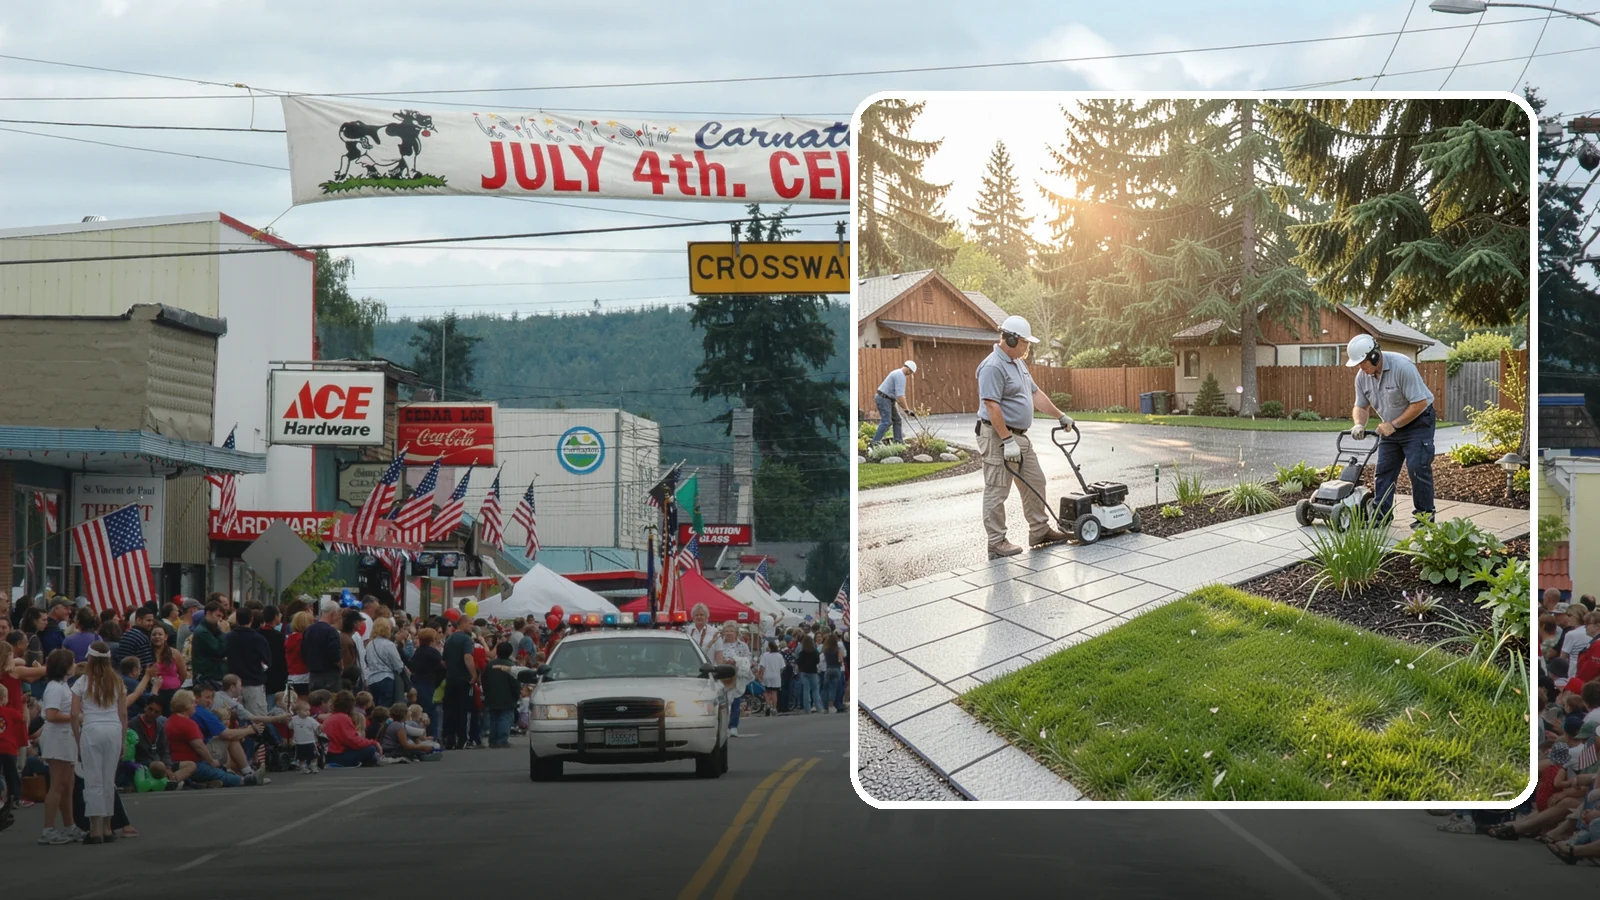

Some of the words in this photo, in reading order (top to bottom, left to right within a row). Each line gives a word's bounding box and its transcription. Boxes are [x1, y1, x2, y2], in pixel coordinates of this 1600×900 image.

[695, 121, 850, 149] Carnat
[481, 141, 605, 192] JULY
[632, 150, 746, 198] 4th.
[697, 254, 850, 280] CROSSWA
[283, 380, 373, 420] ACE
[405, 409, 452, 422] CEDAR
[283, 421, 370, 436] Hardware
[416, 428, 477, 447] Coca-Cola
[96, 485, 124, 494] Vincent
[126, 485, 136, 494] de
[138, 485, 155, 495] Paul
[688, 526, 741, 535] CRNATION
[699, 535, 730, 543] GLASS
